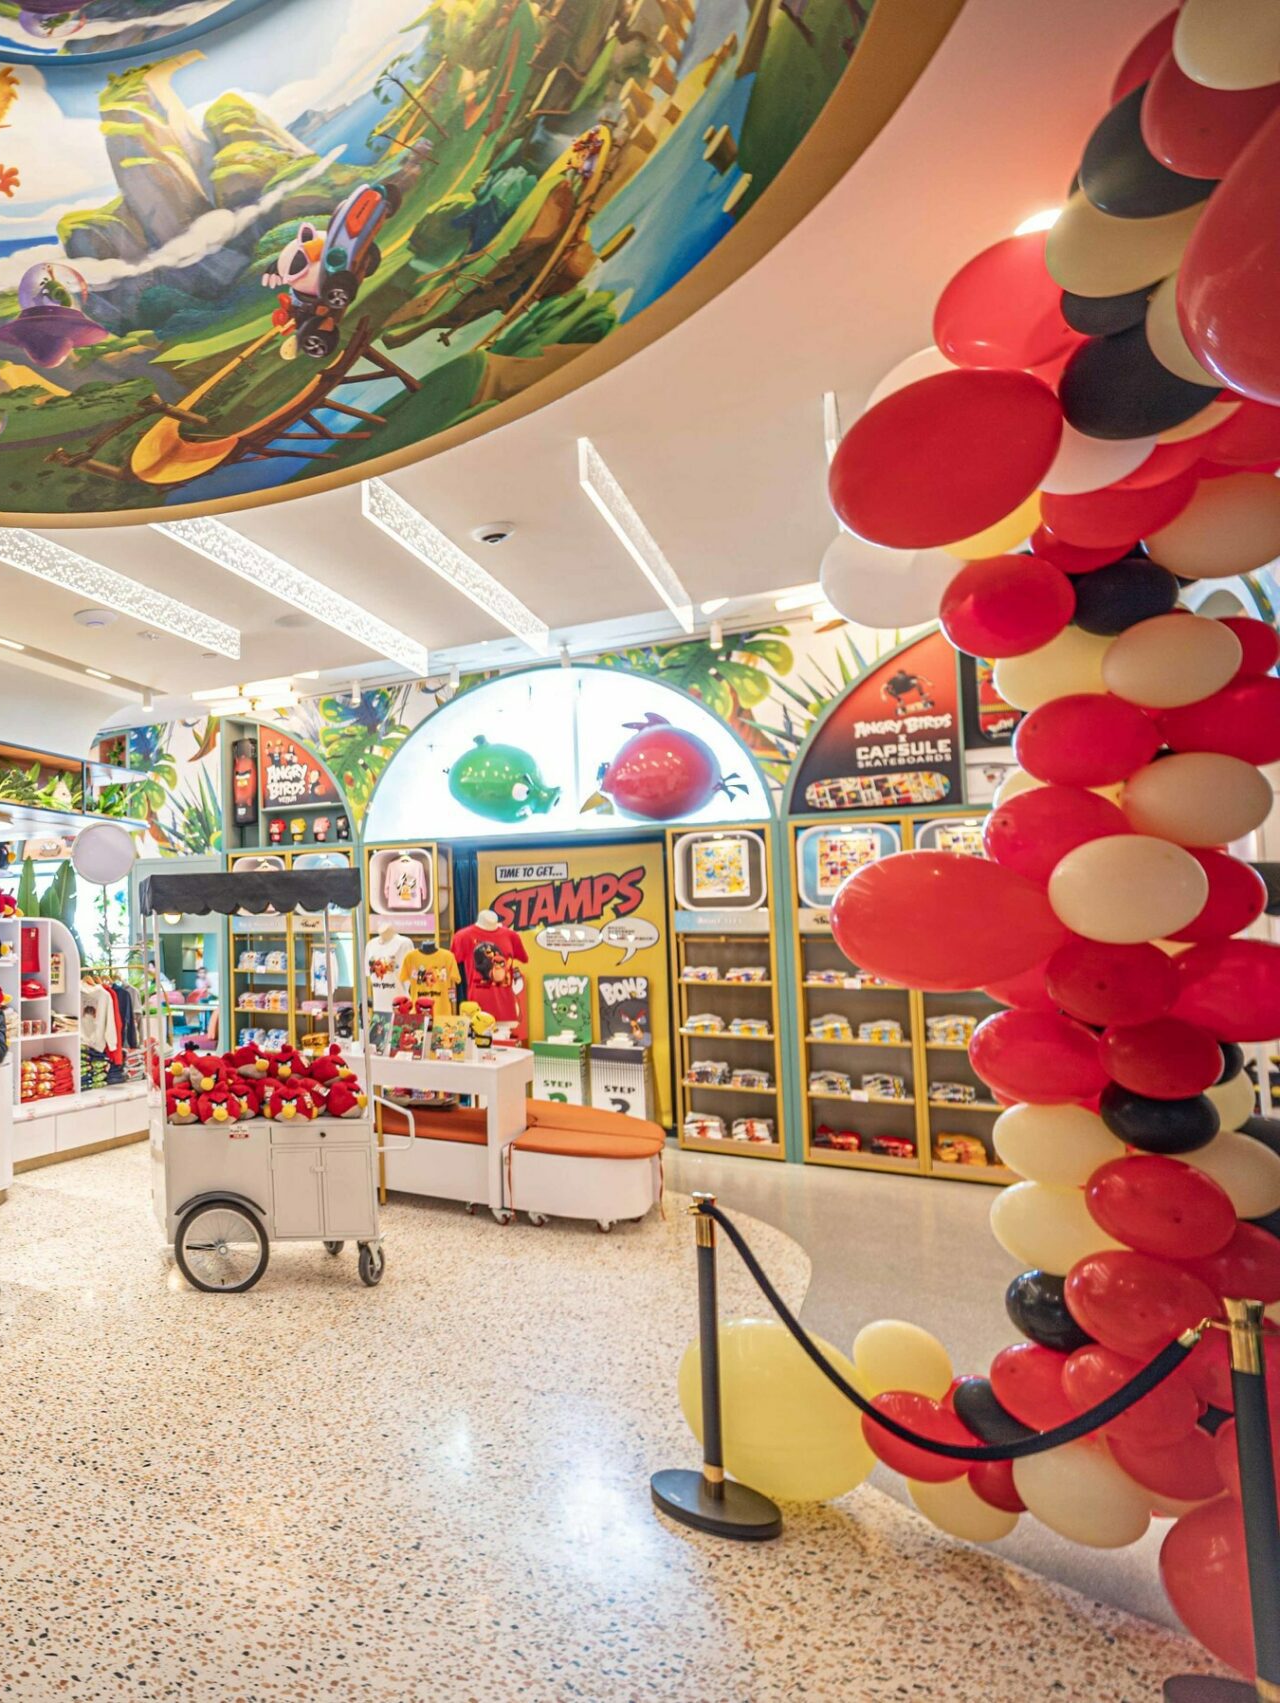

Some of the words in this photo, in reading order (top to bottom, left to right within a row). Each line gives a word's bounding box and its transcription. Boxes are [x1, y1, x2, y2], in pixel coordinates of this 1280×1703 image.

[853, 719, 903, 739] ANGRY
[903, 713, 952, 734] BIRDS
[856, 739, 952, 760] CAPSULE
[857, 754, 952, 769] SKATEBOARDS
[266, 764, 308, 785] ANGRY
[266, 780, 306, 800] BIRDS
[499, 868, 520, 879] TIME
[522, 867, 534, 877] TO
[492, 866, 645, 930] STAMPS
[543, 976, 589, 1001] PIGGY
[599, 977, 647, 1006] BOMB
[543, 1079, 573, 1088] STEP
[604, 1085, 636, 1094] STEP
